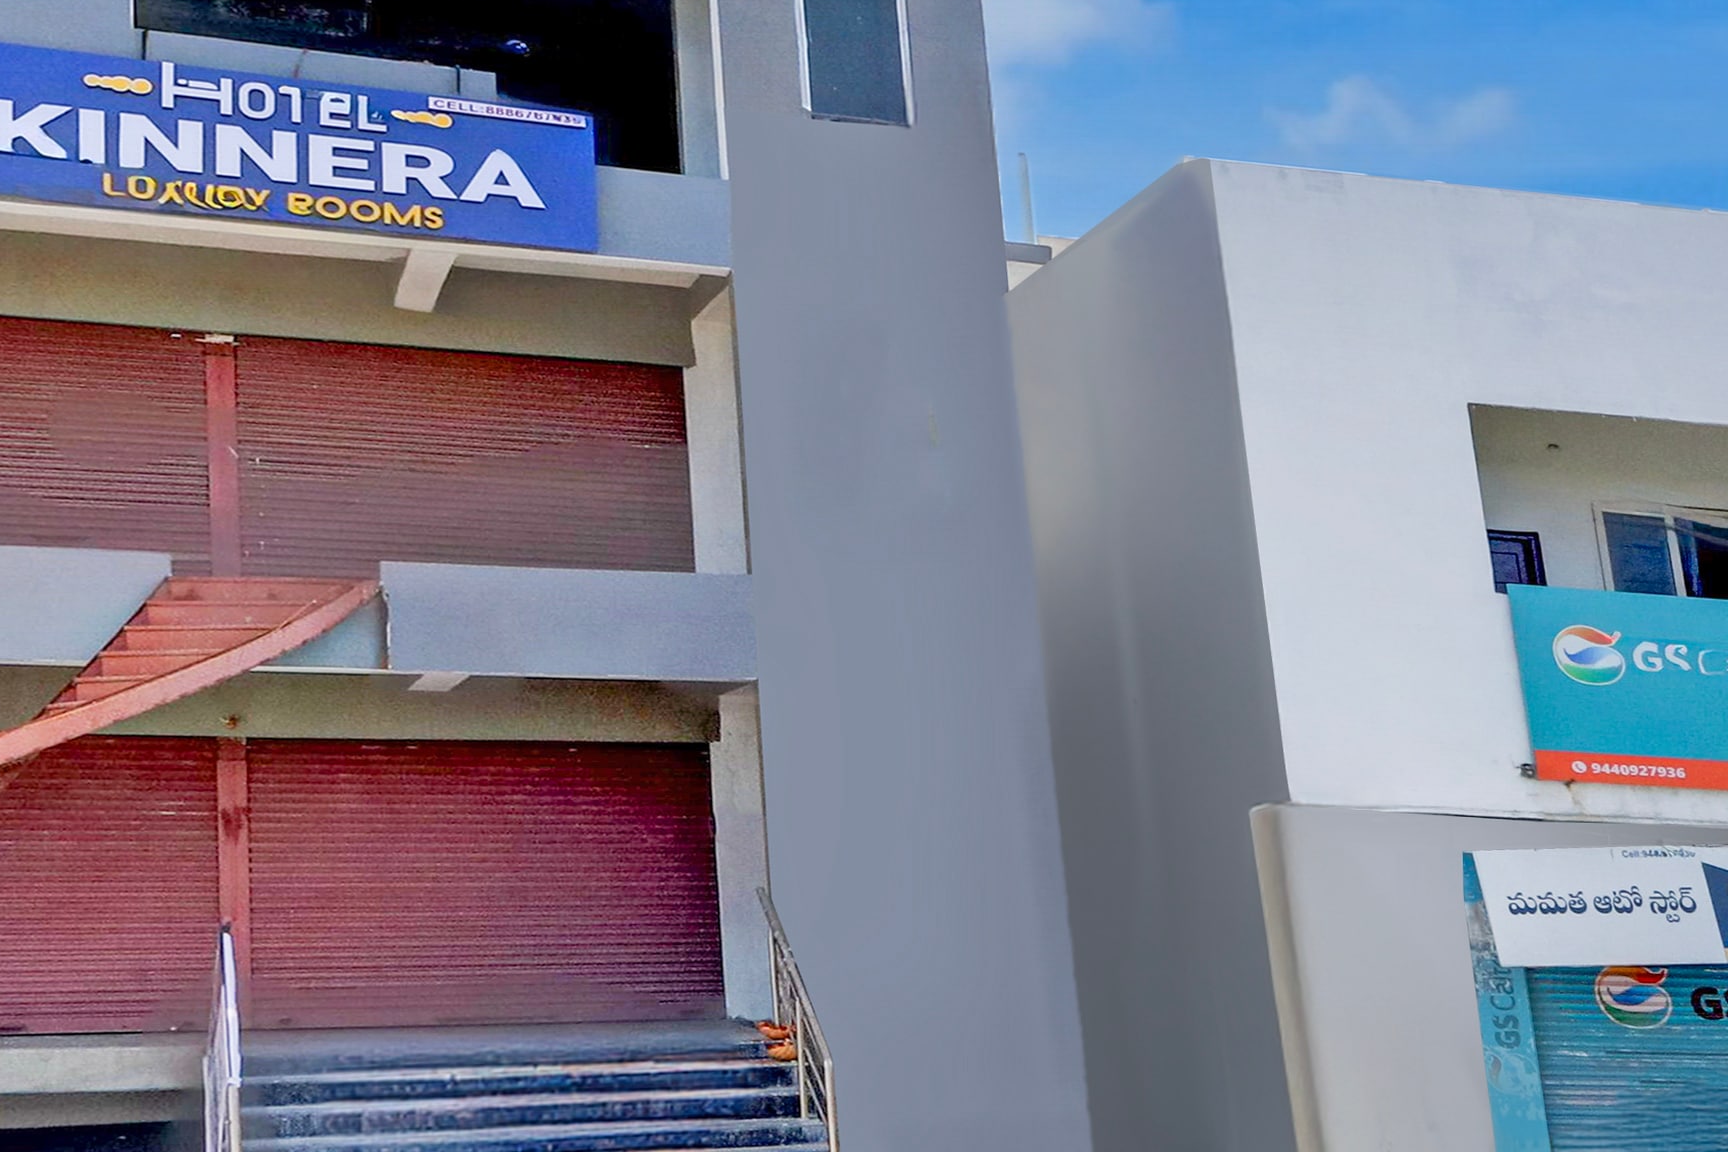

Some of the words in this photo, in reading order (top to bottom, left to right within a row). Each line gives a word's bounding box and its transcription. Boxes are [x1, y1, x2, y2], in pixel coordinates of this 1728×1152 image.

[161, 61, 388, 133] HOTEL
[1591, 762, 1686, 780] 9440927936
[1507, 891, 1588, 915] మమత
